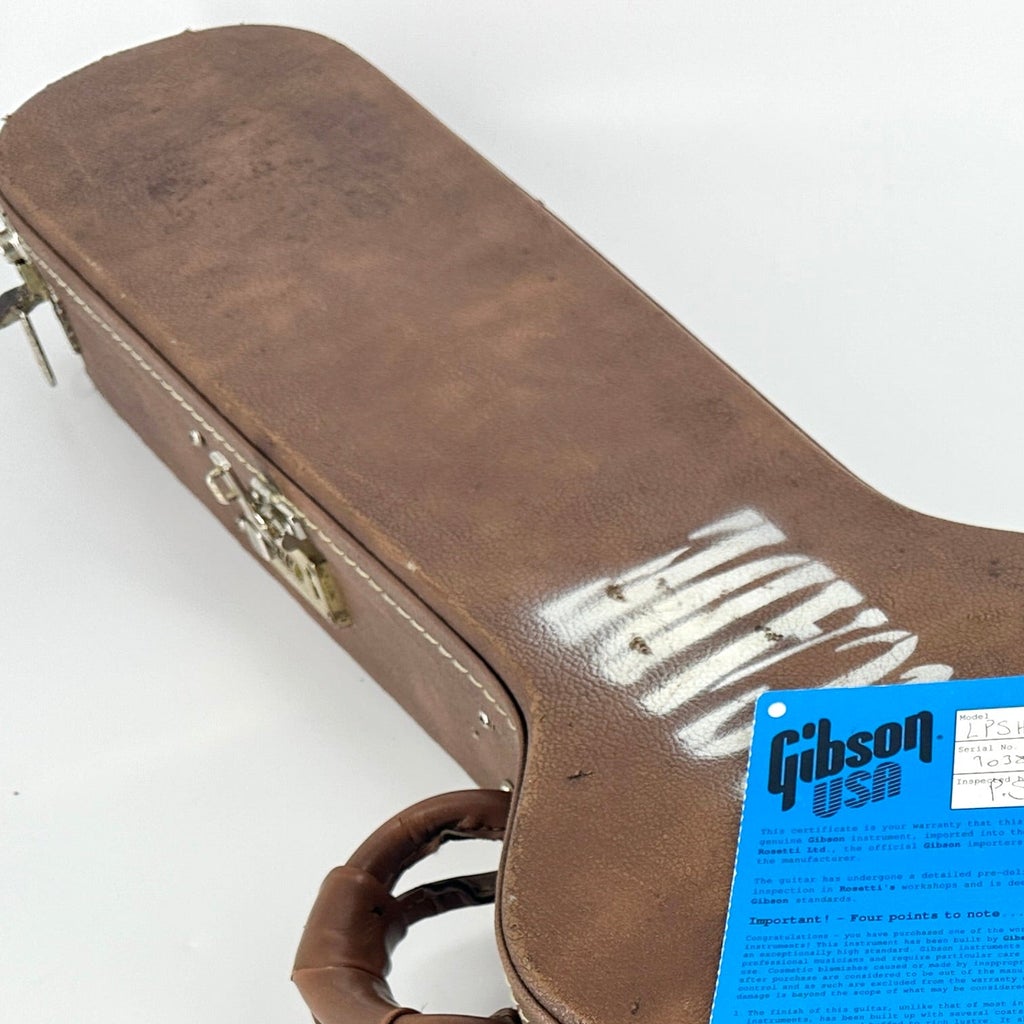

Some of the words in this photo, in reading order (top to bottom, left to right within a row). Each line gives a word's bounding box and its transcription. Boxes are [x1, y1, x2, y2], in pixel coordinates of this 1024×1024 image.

[959, 713, 989, 721] Model
[958, 744, 993, 753] Serial
[768, 710, 933, 812] Gibson
[956, 777, 1011, 786] Inspected
[812, 761, 902, 818] USA
[790, 825, 858, 834] certificate
[912, 821, 961, 830] warranty
[967, 819, 991, 827] that
[758, 837, 802, 847] genuine
[850, 832, 916, 843] instrument,
[925, 830, 974, 840] imported
[757, 847, 800, 855] Rosetti
[868, 842, 916, 850] official
[923, 840, 961, 848] Gibson
[778, 875, 815, 884] guitar
[821, 874, 841, 882] has
[847, 872, 903, 882] undergone
[921, 870, 971, 878] detailed
[752, 886, 815, 896] inspection
[839, 883, 895, 891] Rosetti's
[901, 881, 957, 891] workshops
[795, 894, 857, 903] standards.
[749, 915, 828, 926] Important!
[850, 913, 883, 922] Four
[888, 911, 938, 922] points
[744, 932, 829, 942] Congratulations
[893, 928, 944, 937] purchased
[844, 938, 897, 946] instrument
[759, 949, 832, 959] exceptionally
[959, 942, 1020, 951] instruments
[741, 958, 808, 968] professional
[813, 956, 864, 964] musicians
[935, 951, 991, 960] particular
[767, 966, 813, 974] Cosmetic
[817, 964, 868, 972] blemishes
[737, 984, 776, 992] control
[870, 979, 916, 987] excluded
[971, 975, 1016, 984] warranty
[771, 974, 817, 983] purchase
[844, 971, 901, 979] considered
[735, 992, 770, 1001] damage
[770, 1007, 804, 1015] finish
[853, 1004, 891, 1013] guitar,
[869, 1012, 898, 1020] built
[949, 1008, 988, 1017] several
